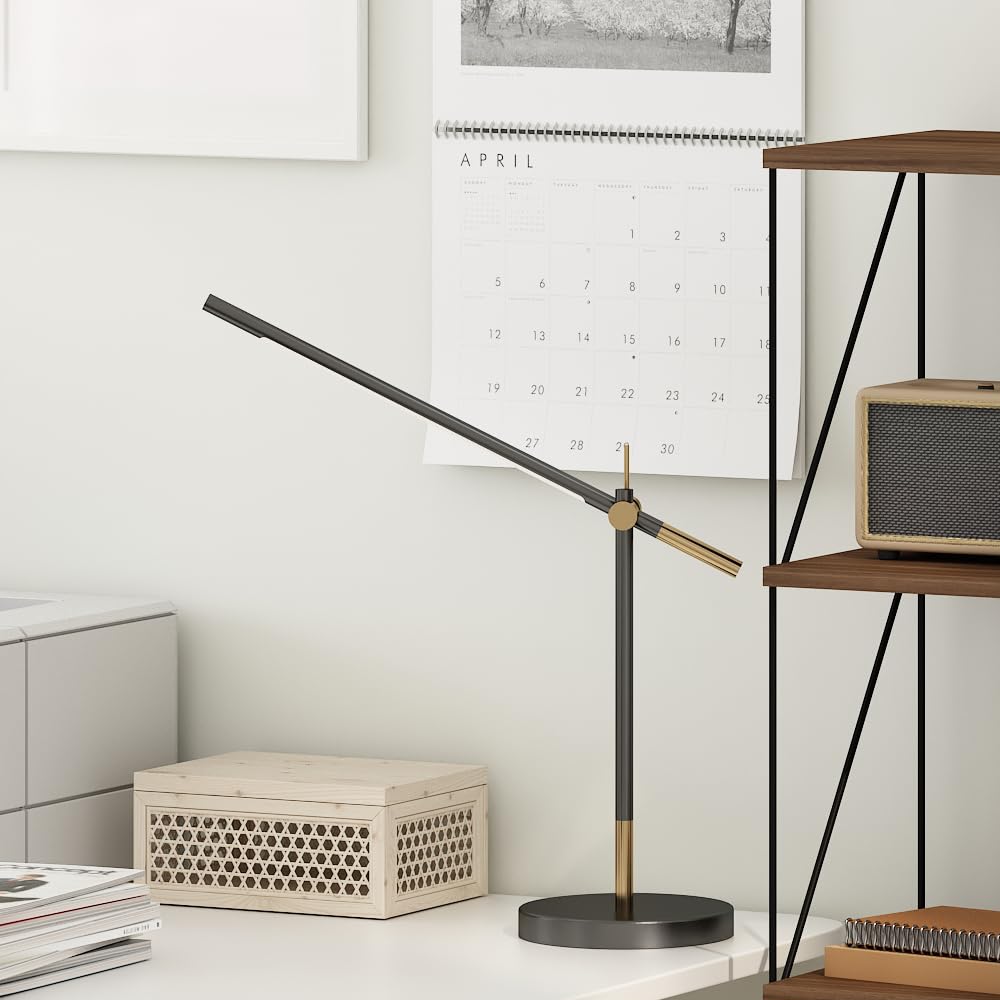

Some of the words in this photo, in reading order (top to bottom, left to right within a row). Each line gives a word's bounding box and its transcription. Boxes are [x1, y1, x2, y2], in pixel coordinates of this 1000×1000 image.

[460, 152, 534, 169] APRIL
[629, 228, 634, 240] 1
[674, 230, 681, 241] 2
[719, 231, 726, 243] 3
[495, 276, 501, 287] 5
[539, 278, 546, 289] 6
[584, 279, 590, 291] 7
[629, 281, 636, 292] 8
[674, 282, 681, 293] 9
[712, 284, 726, 295] 10
[489, 328, 501, 340] 12
[533, 330, 545, 341] 13
[577, 332, 590, 343] 14
[623, 333, 636, 345] 15
[668, 335, 680, 347] 16
[713, 337, 726, 348] 17
[759, 339, 770, 350] 18
[487, 382, 500, 393] 19
[530, 384, 545, 395] 20
[575, 386, 588, 397] 21
[620, 388, 634, 399] 22
[665, 390, 680, 401] 23
[711, 392, 725, 403] 24
[756, 393, 770, 404] 25
[525, 437, 540, 449] 27
[569, 439, 584, 451] 28
[660, 443, 675, 455] 30
